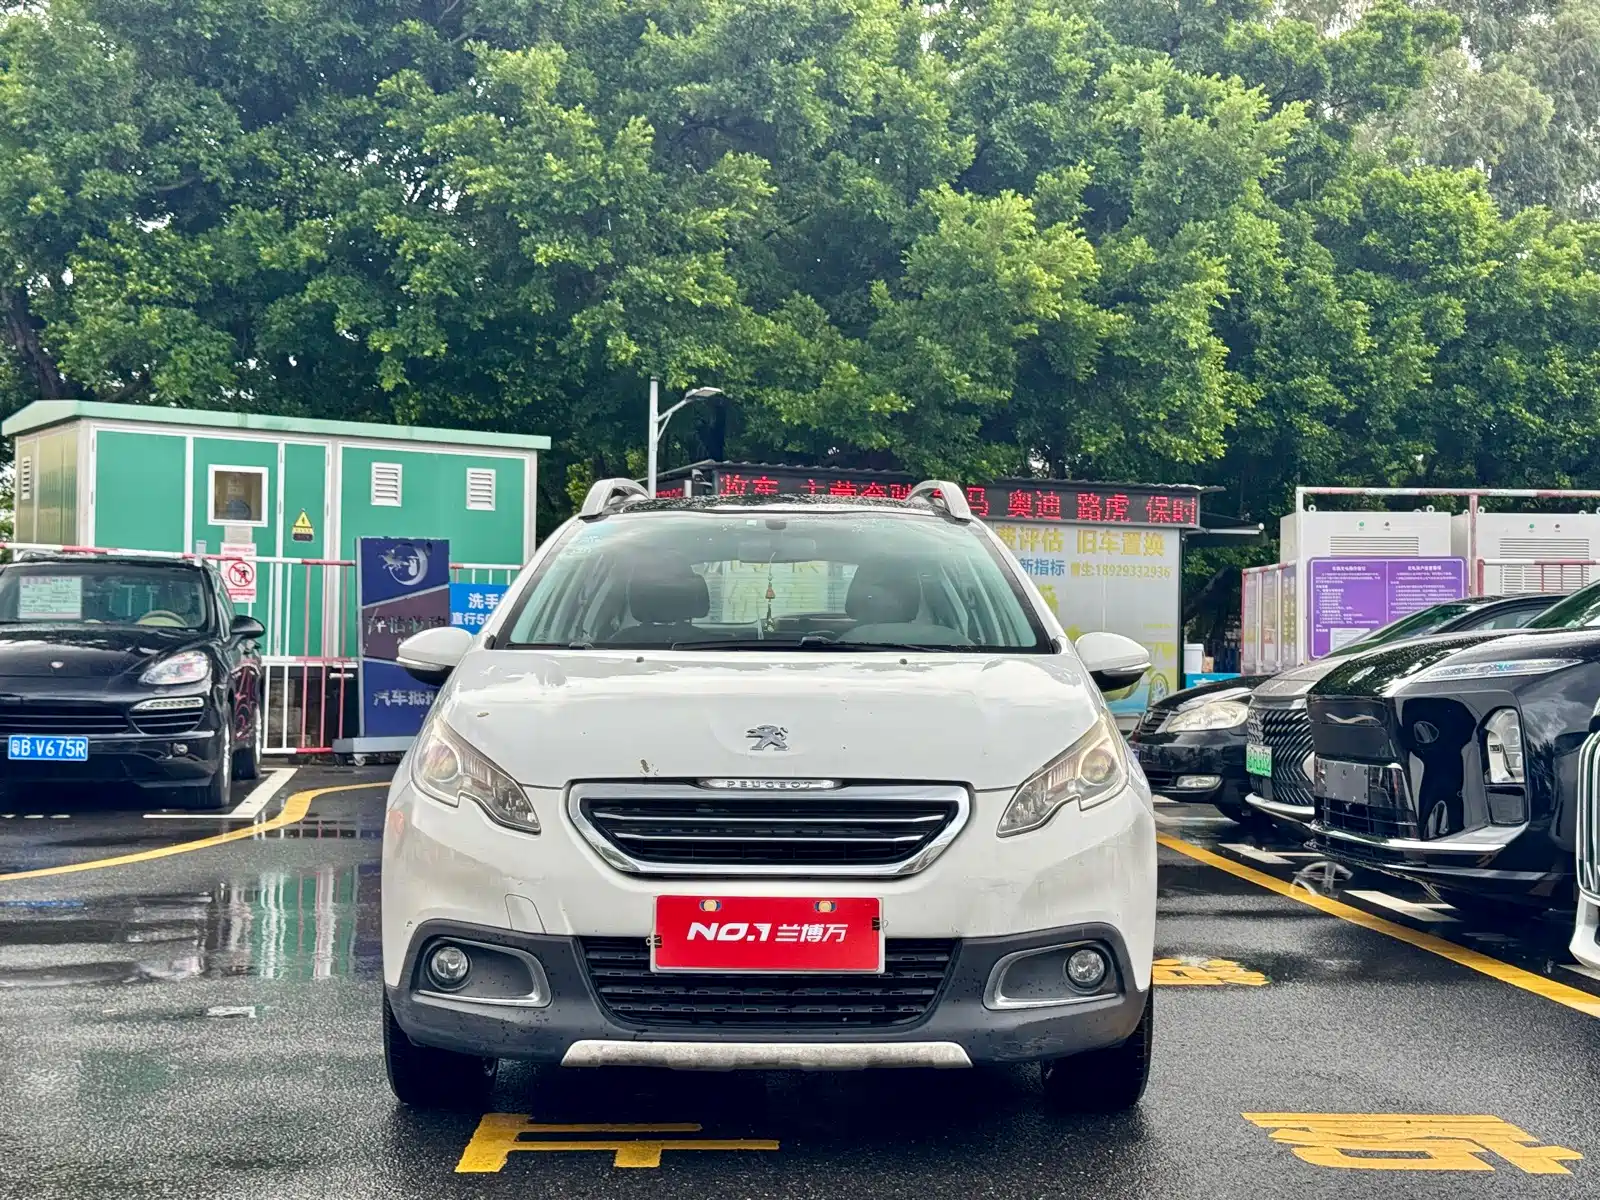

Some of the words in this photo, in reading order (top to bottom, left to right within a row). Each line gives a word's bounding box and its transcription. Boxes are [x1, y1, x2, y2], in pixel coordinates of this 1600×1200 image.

[1008, 489, 1062, 520] 奥迪
[1076, 493, 1131, 523] 路虎
[1146, 496, 1196, 526] 保时
[1077, 530, 1165, 556] 旧车置换
[468, 592, 504, 609] 洗手
[727, 780, 813, 789] PEUGEOT
[687, 922, 772, 942] NO.1
[775, 924, 849, 943] 兰博万
